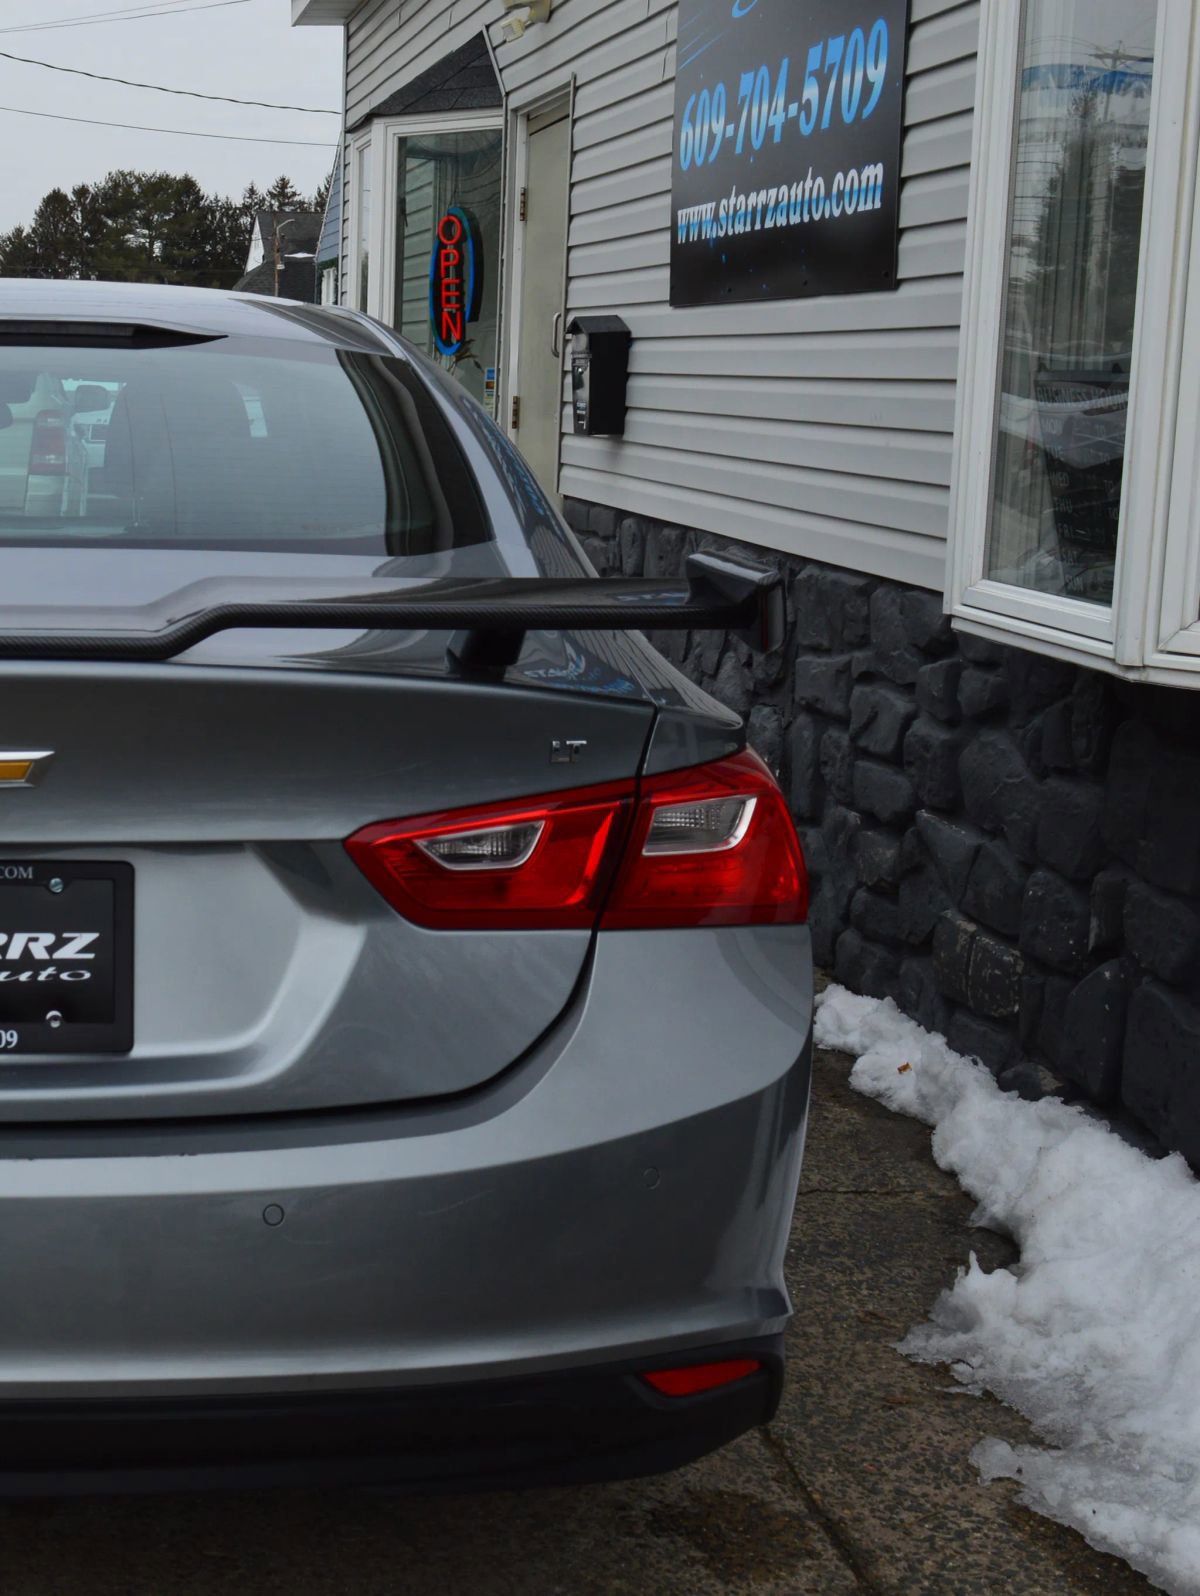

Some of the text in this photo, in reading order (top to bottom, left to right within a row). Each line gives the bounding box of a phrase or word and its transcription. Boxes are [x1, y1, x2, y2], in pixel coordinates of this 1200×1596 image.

[679, 18, 889, 171] 609-704-5709
[677, 162, 884, 244] www.starrzauto.com
[438, 215, 462, 340] OPEN
[551, 740, 588, 762] LT
